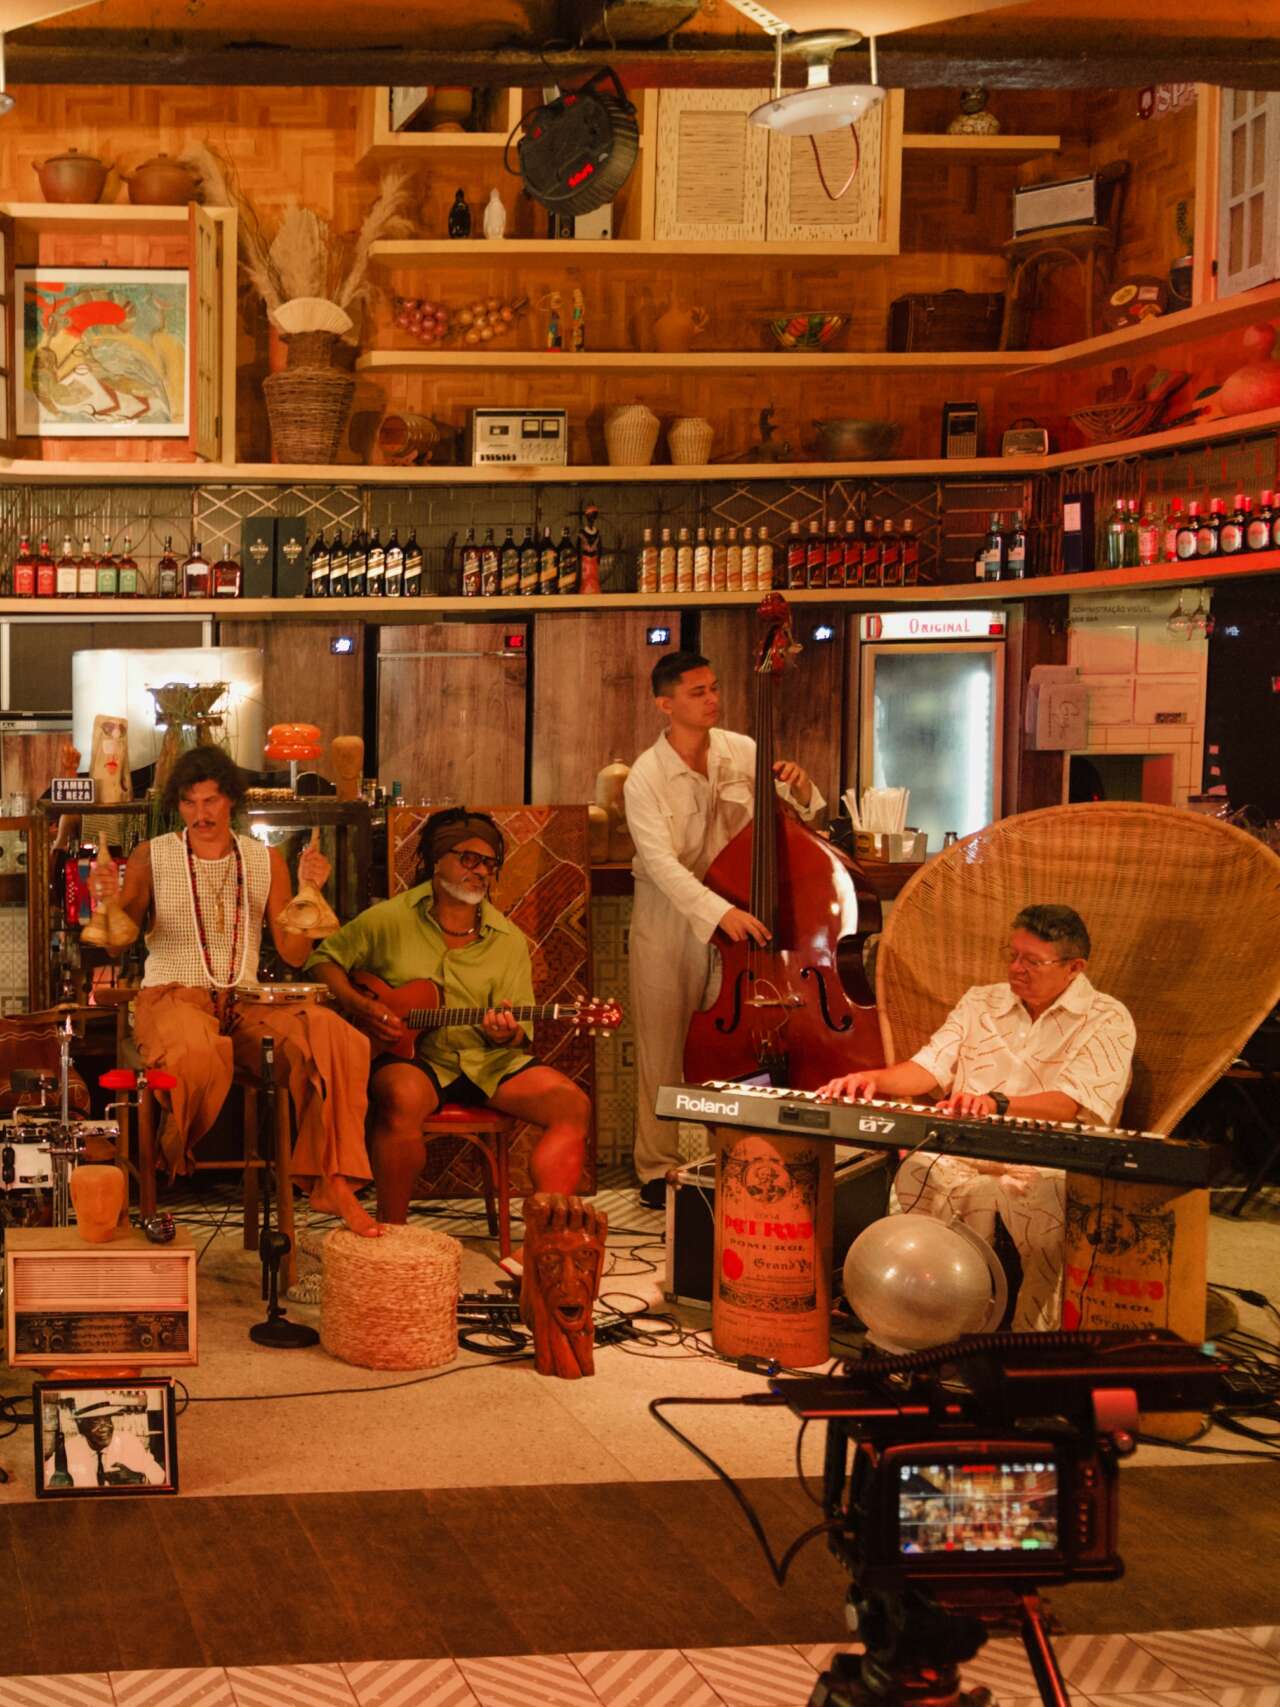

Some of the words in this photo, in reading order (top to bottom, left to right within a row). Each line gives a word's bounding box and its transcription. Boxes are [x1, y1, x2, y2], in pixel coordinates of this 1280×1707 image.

[56, 781, 91, 791] SAMBA
[66, 791, 91, 800] REZA
[676, 1094, 740, 1118] Roland
